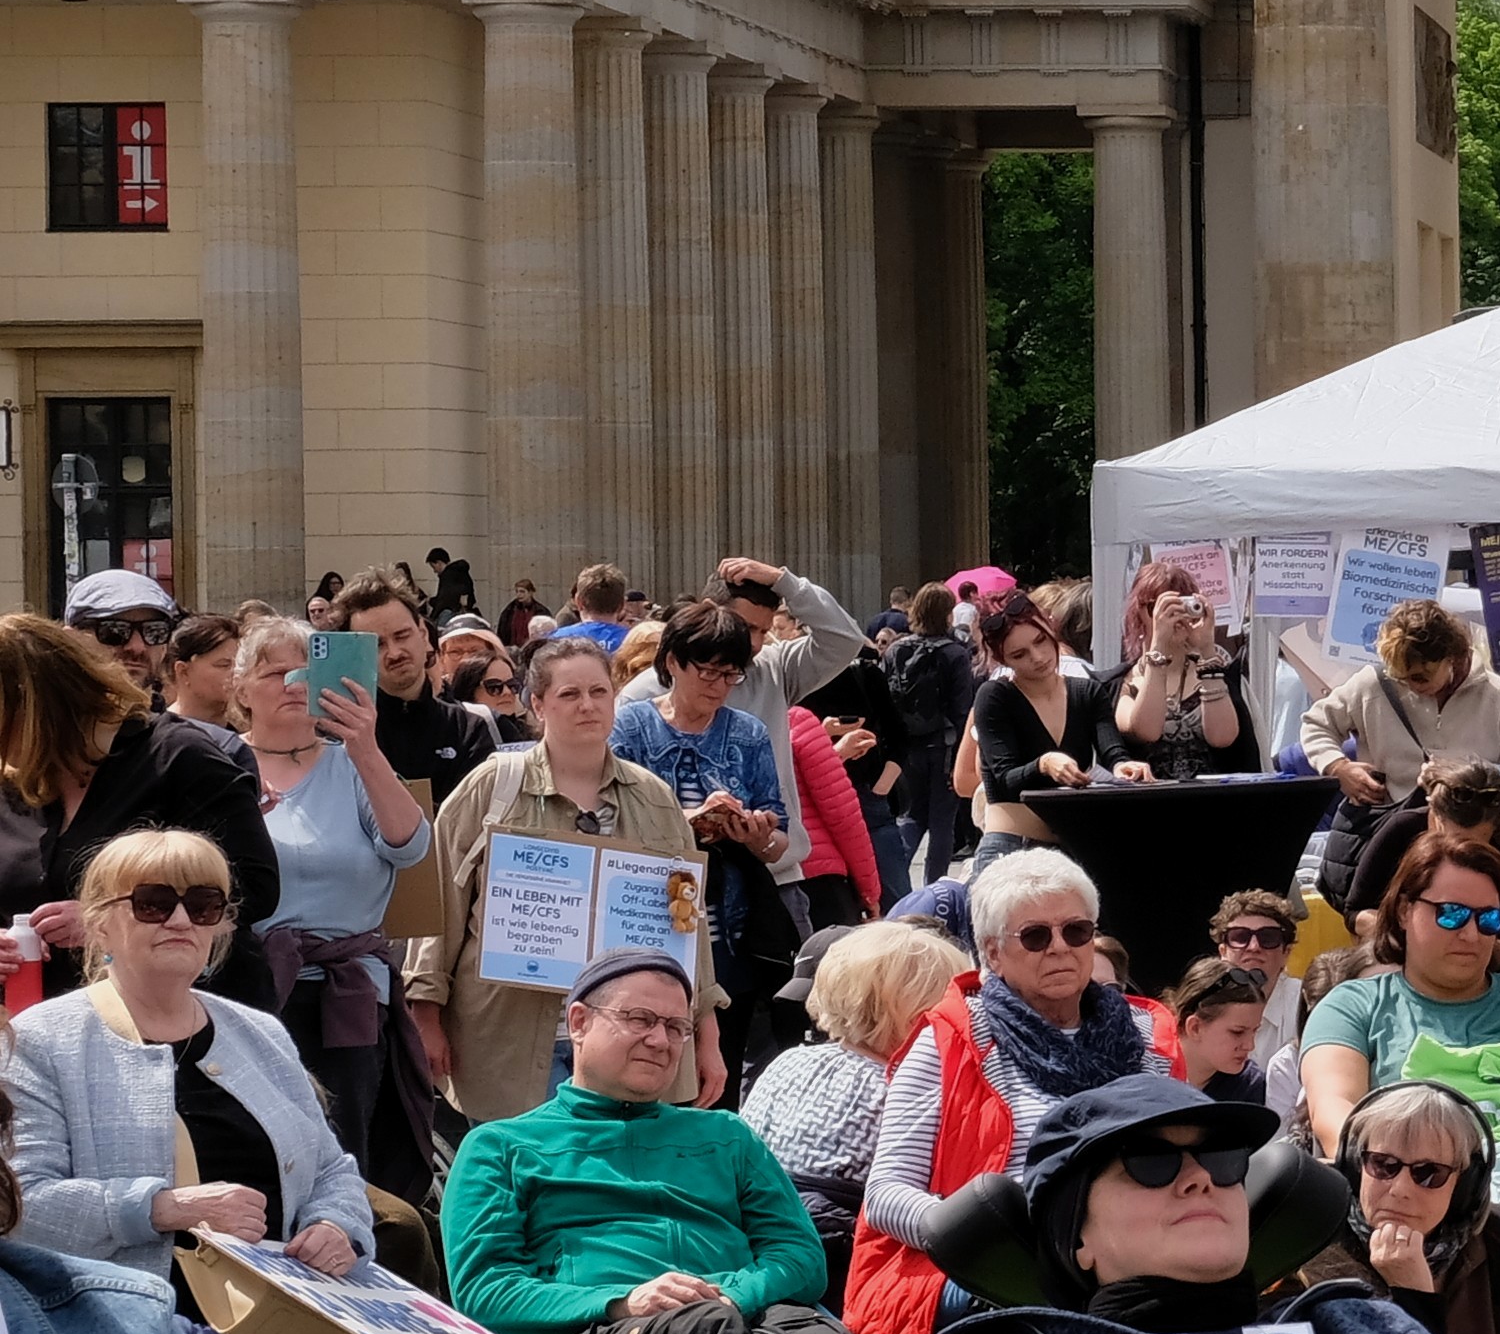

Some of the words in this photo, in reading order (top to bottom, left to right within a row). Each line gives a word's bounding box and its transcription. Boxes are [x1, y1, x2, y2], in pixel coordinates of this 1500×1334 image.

[1415, 534, 1429, 543] an
[1258, 548, 1278, 557] WIR
[1280, 549, 1328, 557] FORDERN
[1363, 536, 1428, 558] ME/CFS
[1206, 551, 1220, 560] an
[1261, 560, 1326, 571] Anerkennung
[1347, 556, 1365, 566] Wir
[1368, 562, 1401, 574] wollen
[1404, 565, 1436, 580] leben!
[1281, 570, 1305, 579] statt
[1263, 581, 1324, 591] Missachtung
[1342, 570, 1438, 595] Biomedizinische
[513, 849, 570, 868] ME/CFS
[623, 881, 660, 896] Zugang
[491, 885, 513, 899] EIN
[515, 888, 557, 905] LEBEN
[559, 894, 584, 908] MIT
[511, 903, 561, 920] ME/CFS
[491, 915, 505, 927] ist
[508, 918, 528, 930] wie
[530, 918, 580, 938] lebendig
[620, 919, 634, 931] für
[637, 923, 656, 933] alle
[657, 926, 671, 935] an
[506, 929, 563, 946] begraben
[625, 934, 665, 948] ME/CFS
[513, 943, 527, 954] zu
[529, 945, 556, 957] sein!
